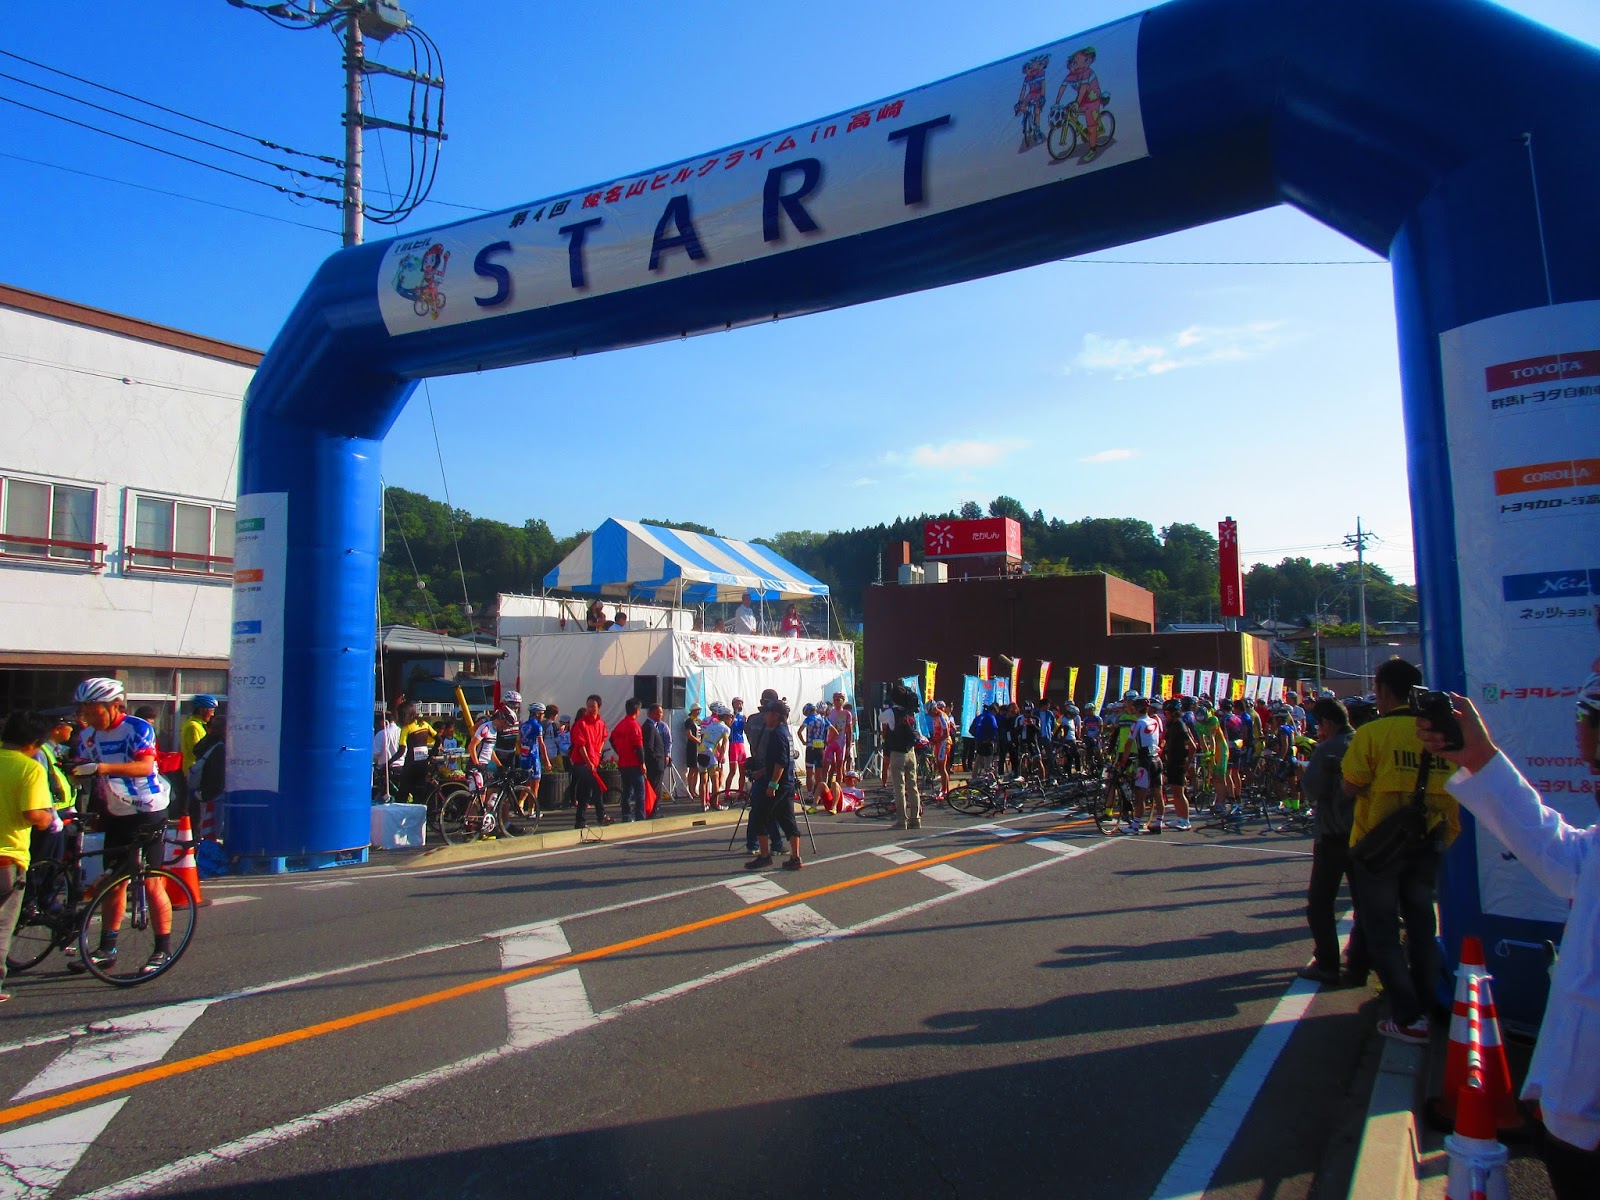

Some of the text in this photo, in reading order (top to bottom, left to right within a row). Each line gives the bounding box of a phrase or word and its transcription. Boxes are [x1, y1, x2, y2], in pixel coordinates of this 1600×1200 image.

[508, 99, 906, 228] 第4回 榛名山ヒルクライム in 高崎
[473, 114, 951, 307] START
[1510, 360, 1583, 379] TOYOTA
[1522, 466, 1589, 484] COROLLA
[972, 532, 1000, 541] たかしん
[1526, 756, 1585, 767] TOYOTA
